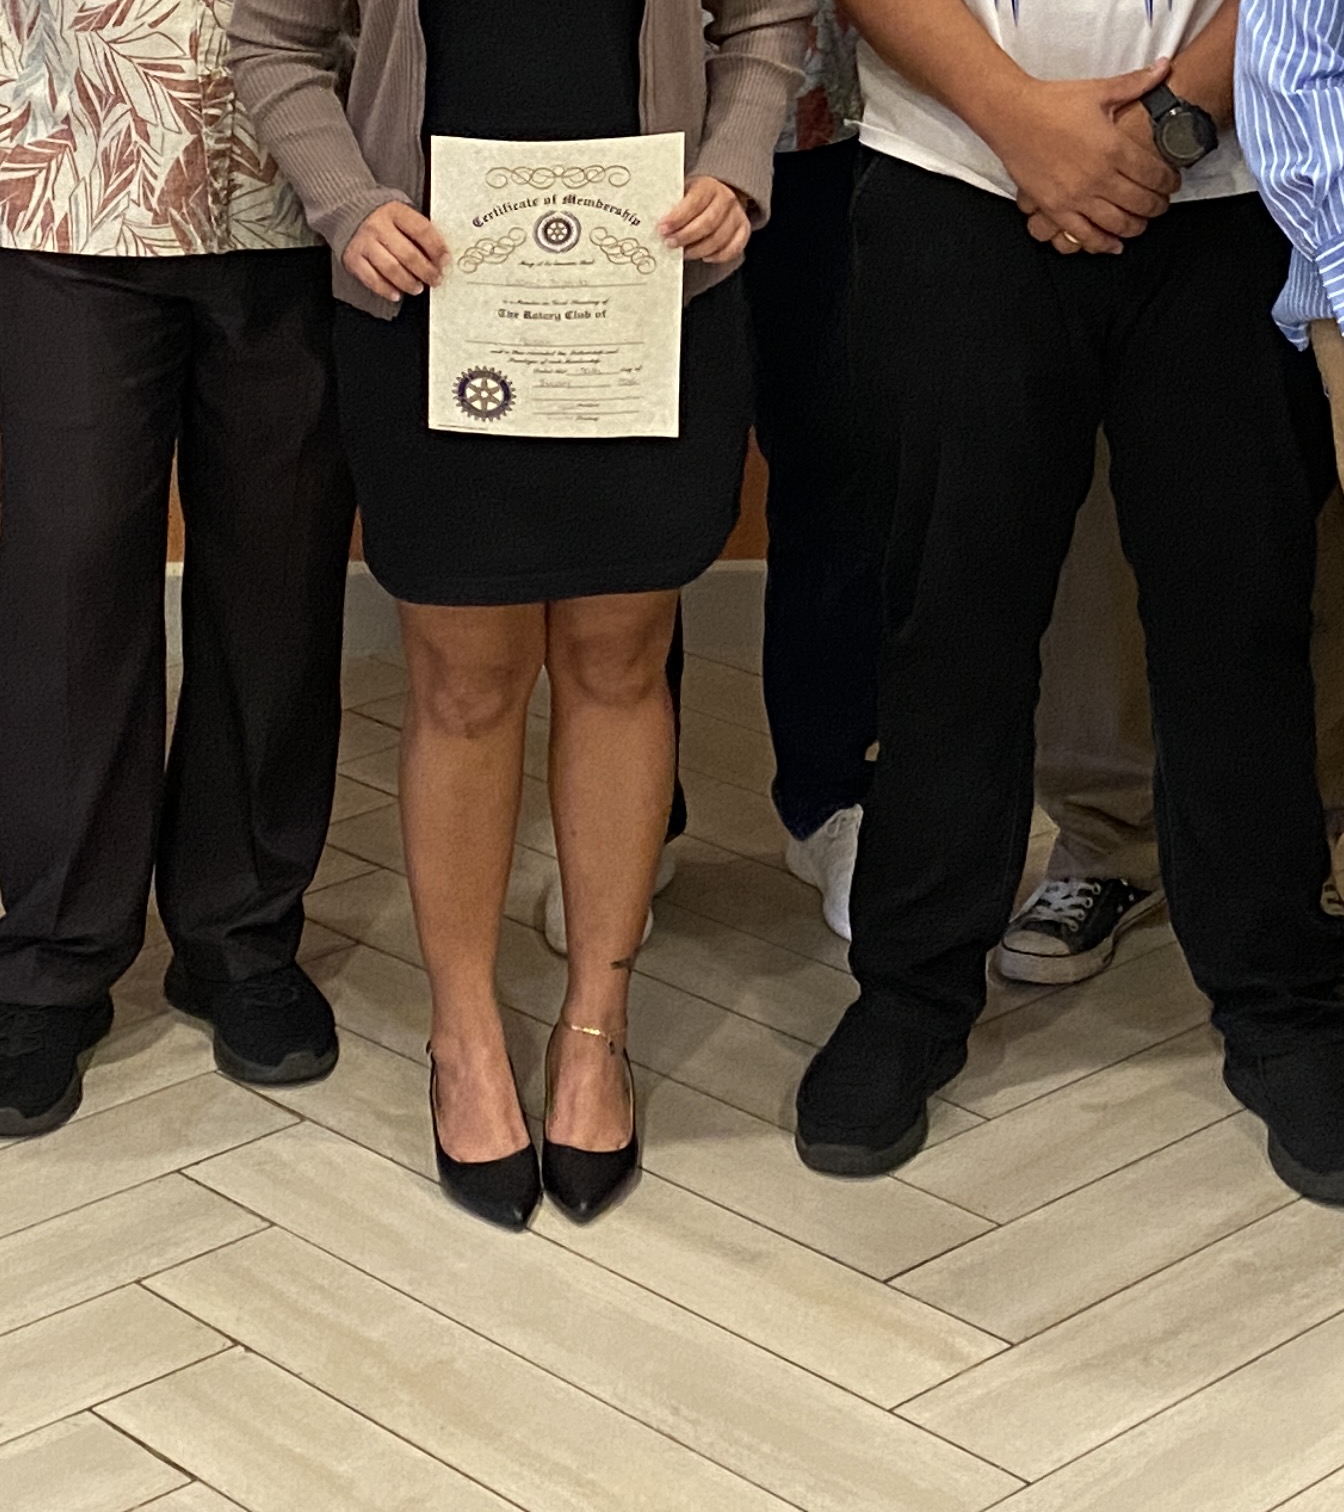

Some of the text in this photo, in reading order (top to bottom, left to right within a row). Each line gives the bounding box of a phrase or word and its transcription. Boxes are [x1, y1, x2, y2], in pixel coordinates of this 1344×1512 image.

[472, 193, 642, 228] Certificate of Membership
[564, 310, 592, 320] Club
[595, 309, 607, 319] of
